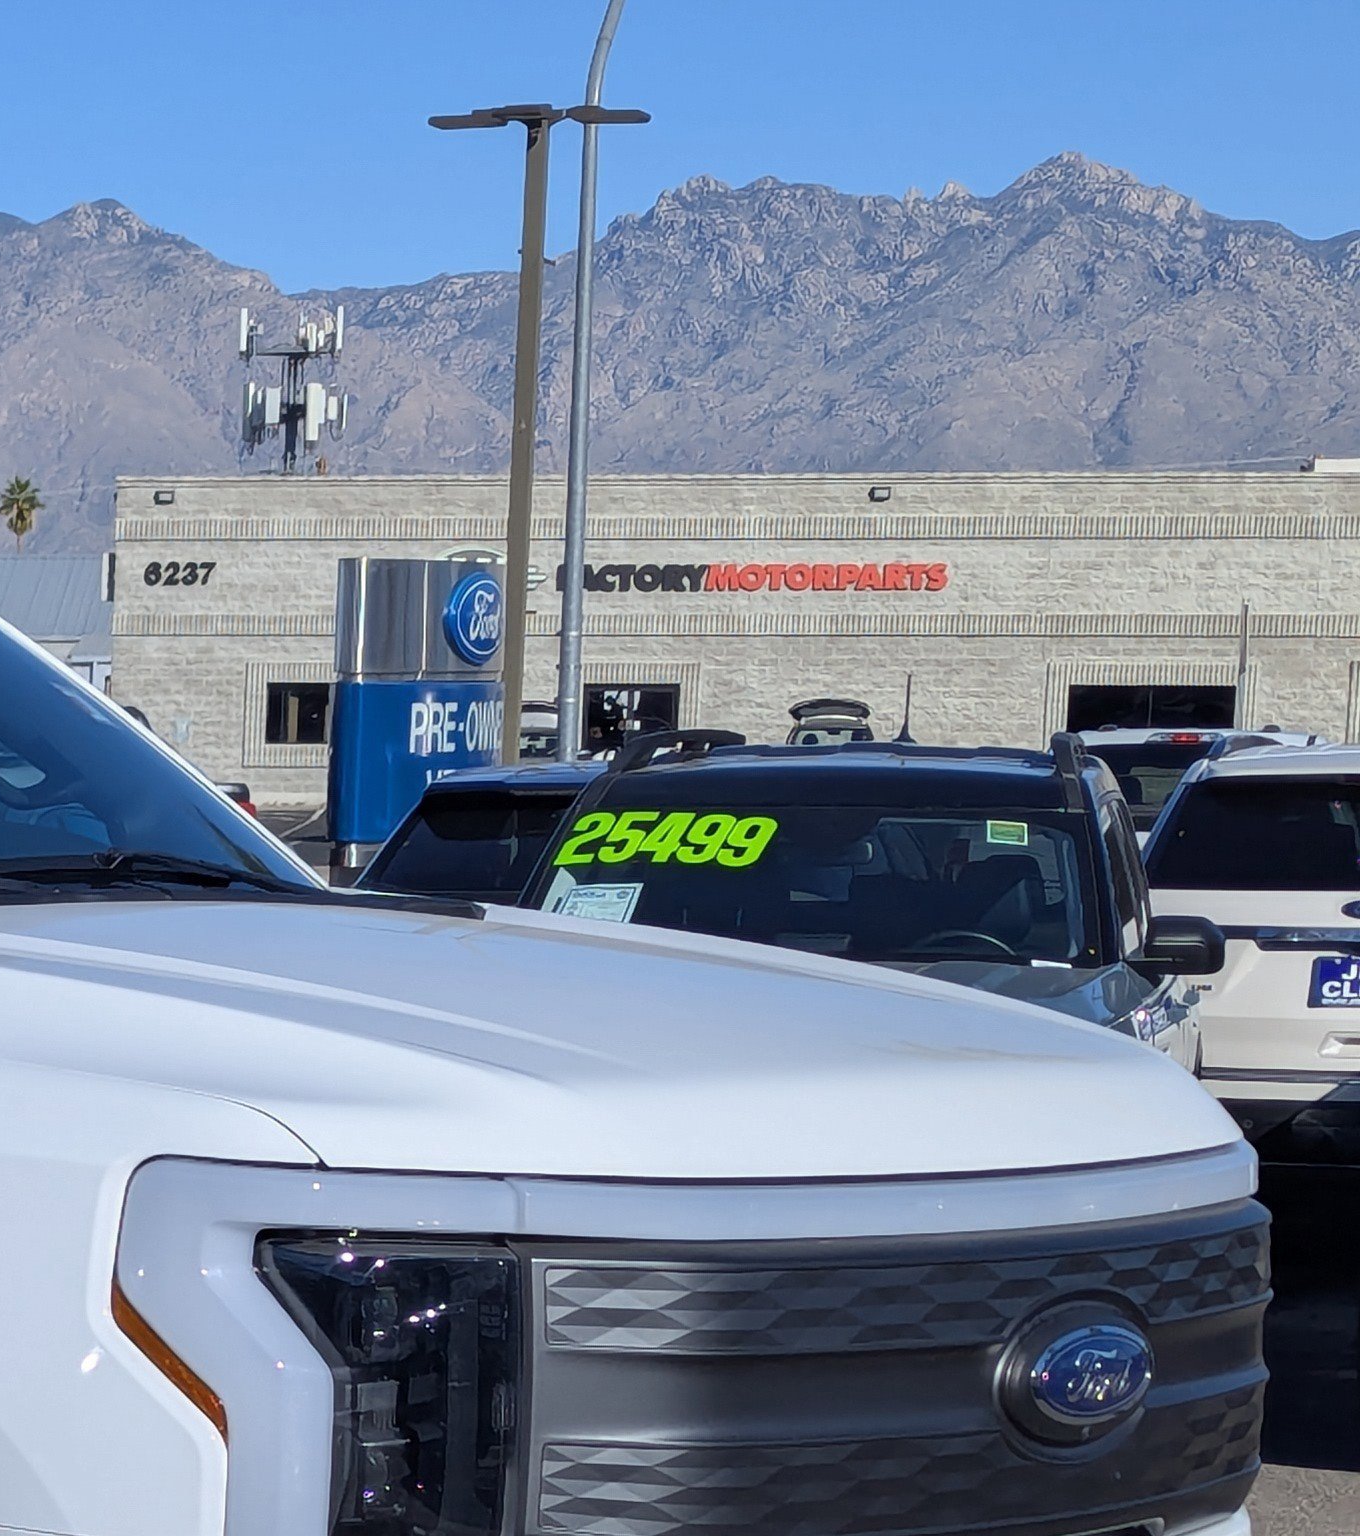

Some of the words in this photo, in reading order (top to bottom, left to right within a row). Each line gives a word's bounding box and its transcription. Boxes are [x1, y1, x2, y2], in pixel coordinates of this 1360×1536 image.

[143, 561, 217, 586] 6237
[409, 701, 504, 754] PRE-OWNE
[553, 811, 779, 867] 25499
[1322, 981, 1360, 997] CL
[1066, 1348, 1133, 1403] Ford
